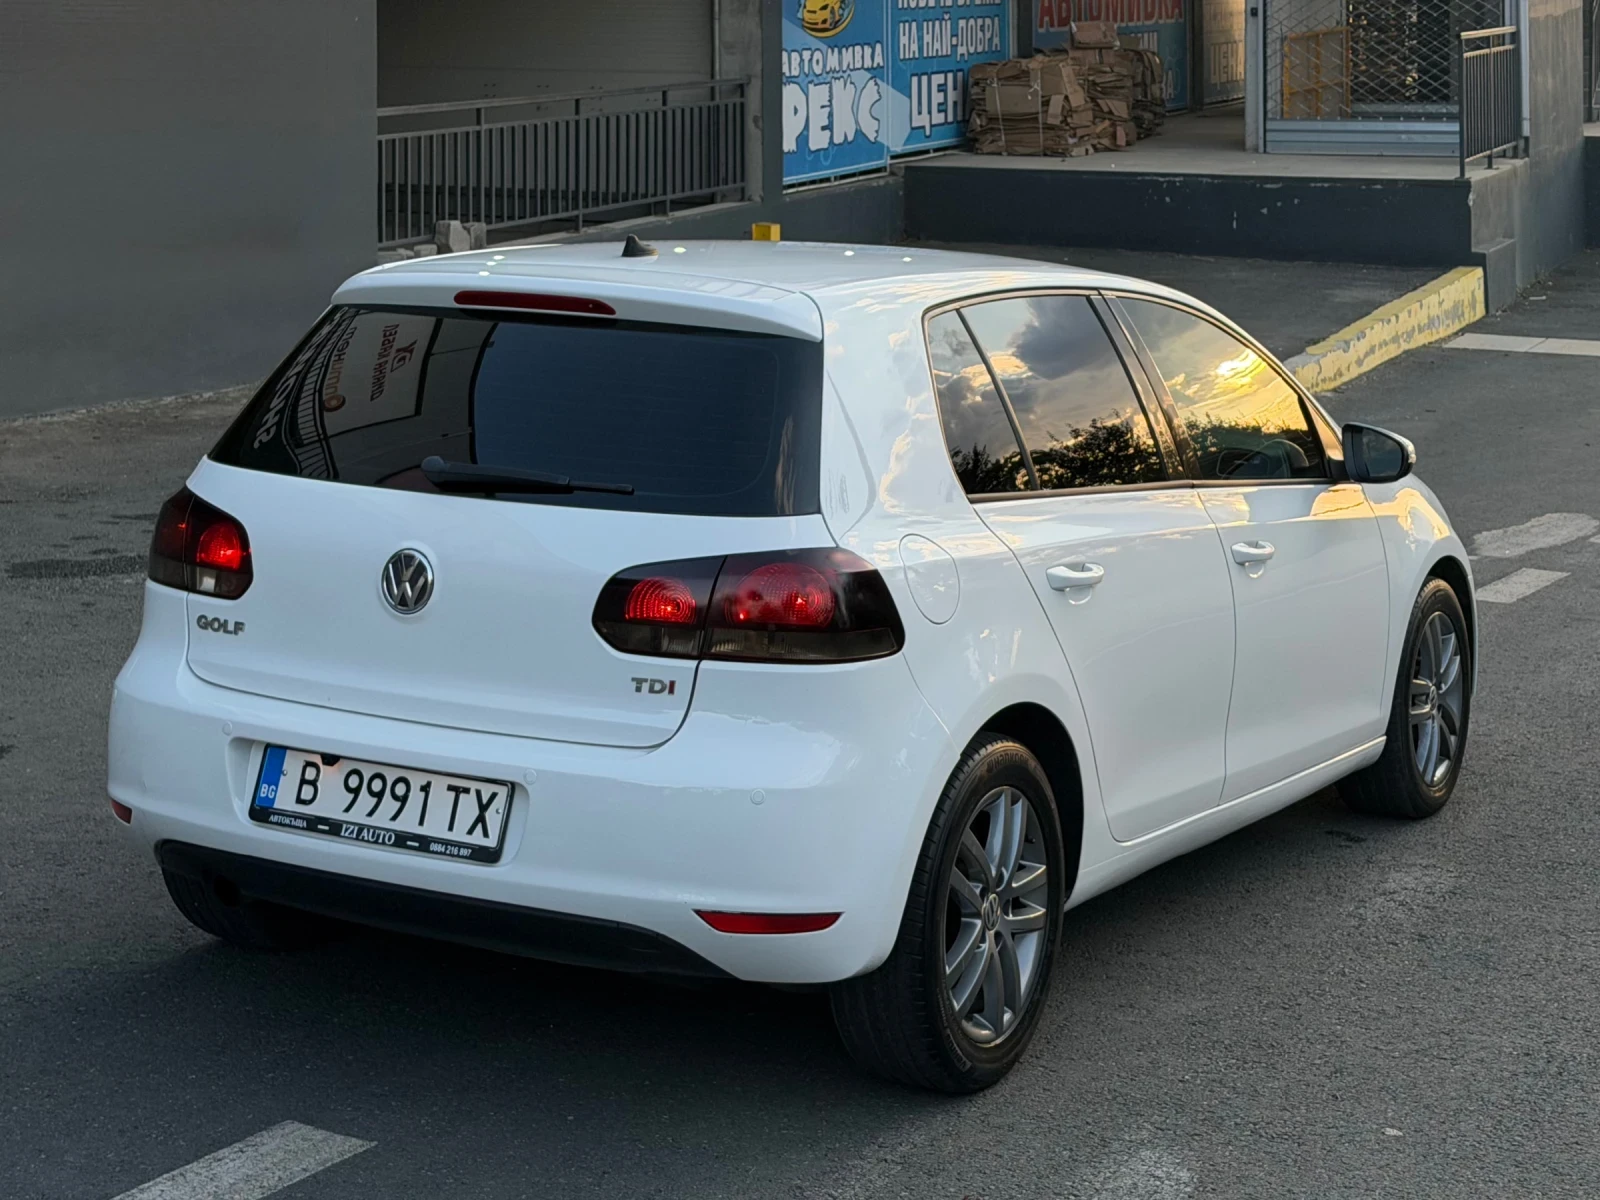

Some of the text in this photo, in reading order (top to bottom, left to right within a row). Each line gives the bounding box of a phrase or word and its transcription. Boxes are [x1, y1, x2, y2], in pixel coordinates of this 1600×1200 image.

[899, 12, 1001, 61] НА НАЙ-ДОБРА
[782, 41, 884, 78] АВТОМИВКА
[782, 75, 881, 153] РЕКС
[911, 71, 965, 136] ЦЕН
[196, 614, 246, 636] GOLF
[631, 677, 676, 695] TDI
[259, 783, 277, 799] BG
[295, 760, 499, 839] B 9991 TX
[340, 823, 396, 845] IZI AUTO
